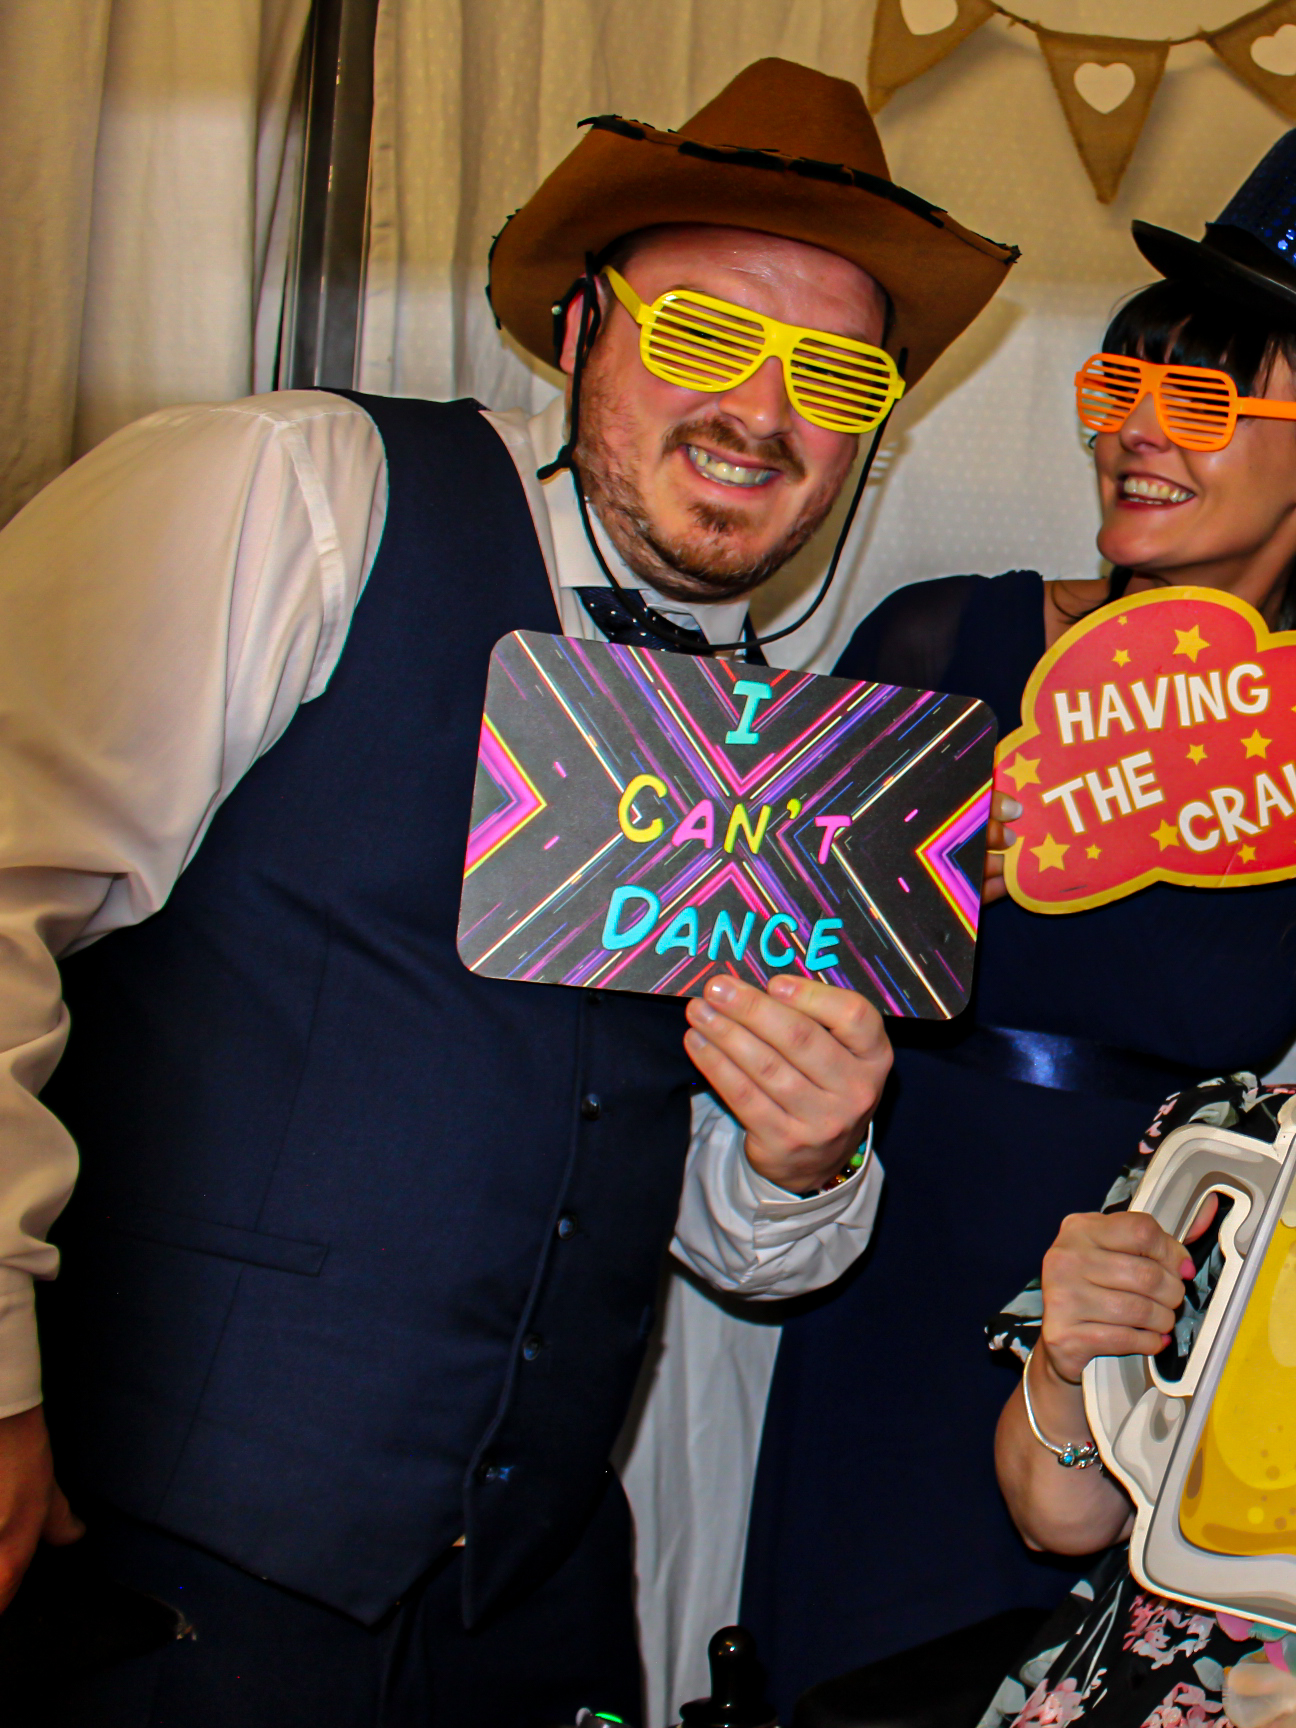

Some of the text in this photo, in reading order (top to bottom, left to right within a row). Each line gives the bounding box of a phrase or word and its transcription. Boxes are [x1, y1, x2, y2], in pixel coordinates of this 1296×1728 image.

[725, 680, 773, 745] I
[1054, 663, 1269, 745] HAVING
[618, 774, 852, 864] CAN'T
[1042, 751, 1165, 834] THE
[602, 885, 843, 971] DANCE
